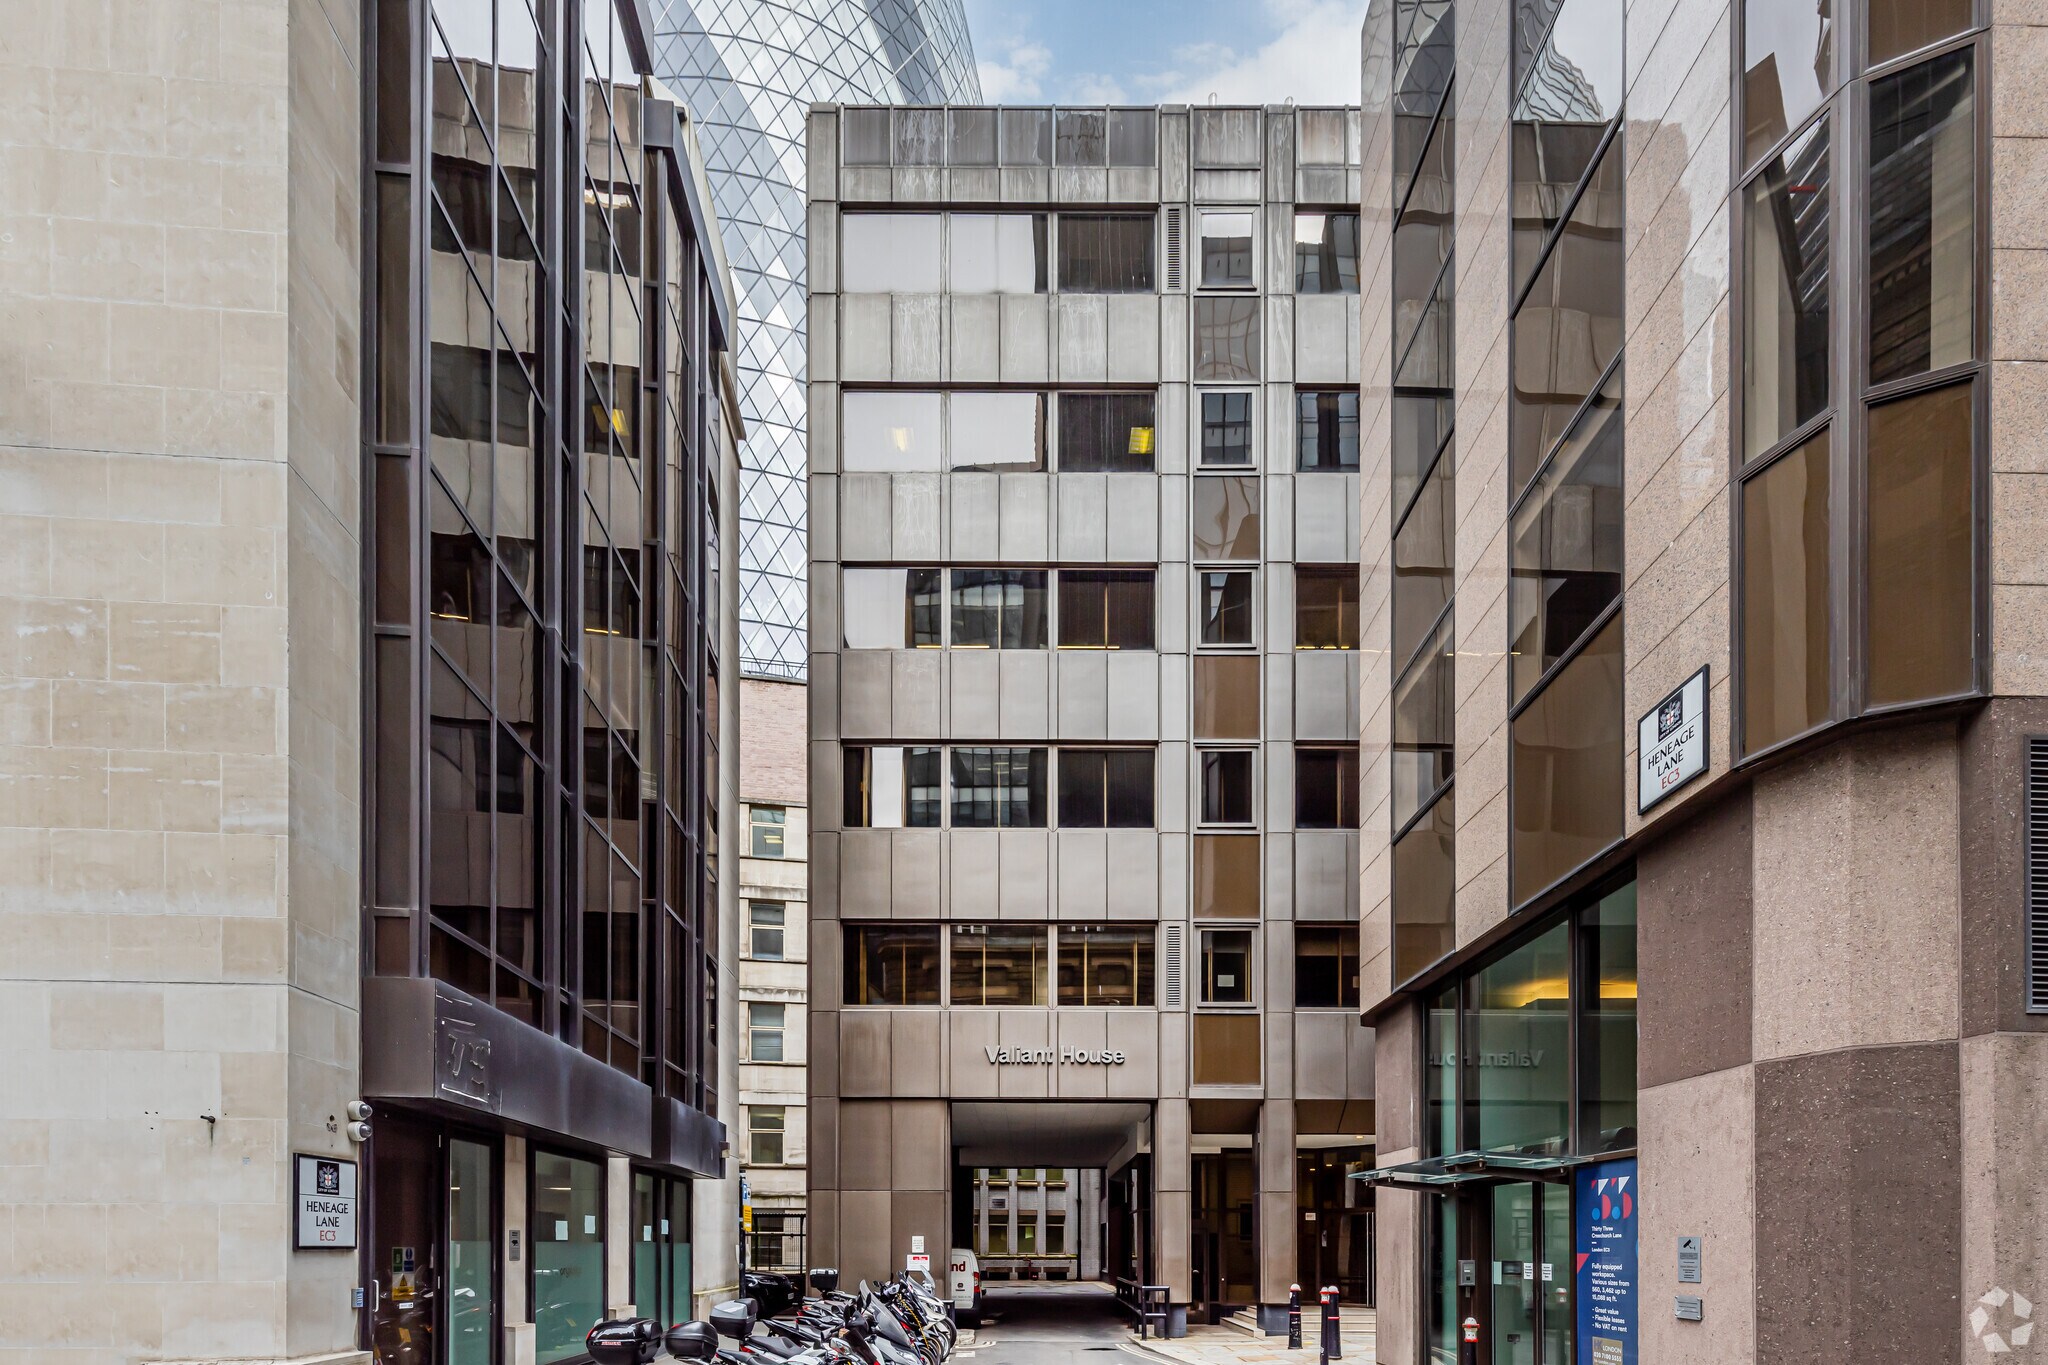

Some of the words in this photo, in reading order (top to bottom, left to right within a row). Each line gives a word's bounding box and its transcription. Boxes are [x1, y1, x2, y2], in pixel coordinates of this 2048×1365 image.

[1648, 725, 1694, 770] HENEAGE
[1658, 749, 1684, 777] LANE
[1662, 768, 1680, 790] EC3
[984, 1044, 1053, 1065] Valiant
[1060, 1044, 1126, 1065] House
[306, 1201, 348, 1213] HENEAGE
[316, 1216, 339, 1227] LANE
[320, 1230, 336, 1241] EC3
[1602, 1345, 1622, 1354] LONDON
